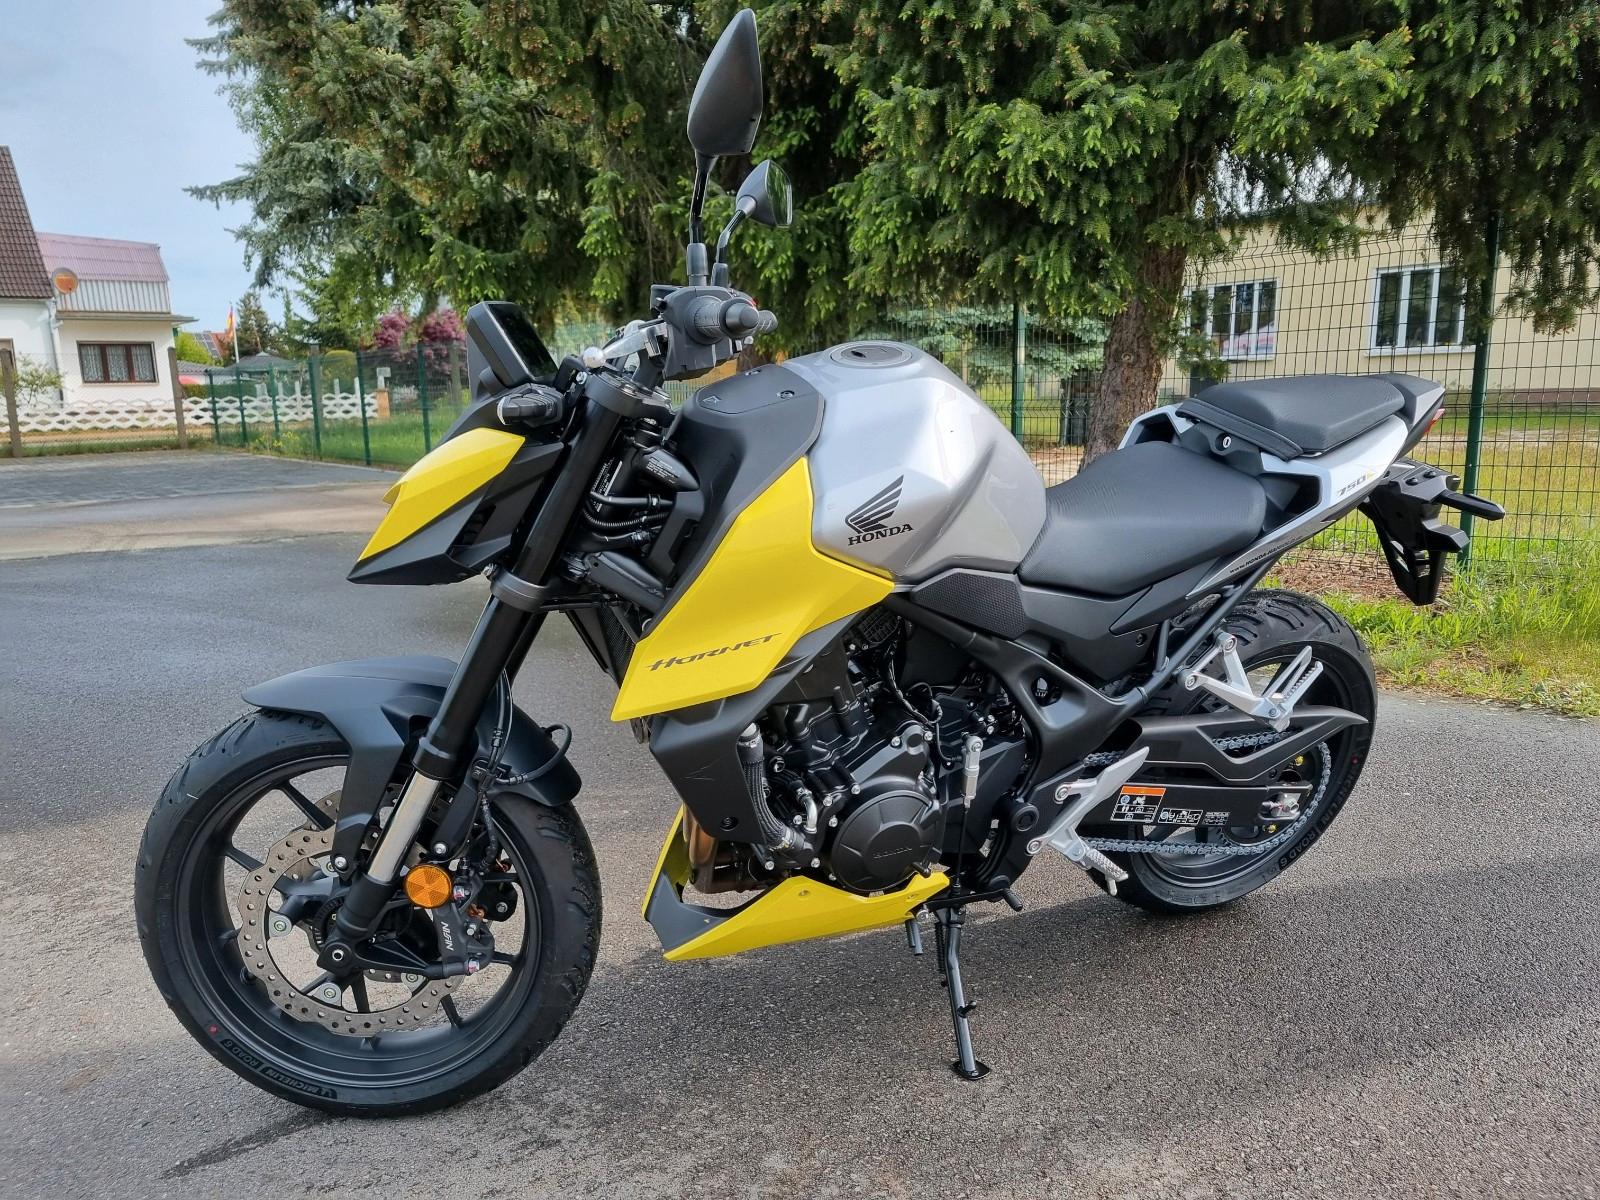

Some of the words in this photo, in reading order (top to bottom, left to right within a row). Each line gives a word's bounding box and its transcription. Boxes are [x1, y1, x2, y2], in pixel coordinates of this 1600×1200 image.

[848, 524, 914, 546] HONDA
[645, 632, 782, 671] HORNET
[1288, 830, 1316, 859] ROAD
[441, 921, 454, 951] NISSIN
[223, 1039, 233, 1048] 6
[231, 1046, 260, 1067] ROAD
[265, 1067, 319, 1094] MICHELIN
